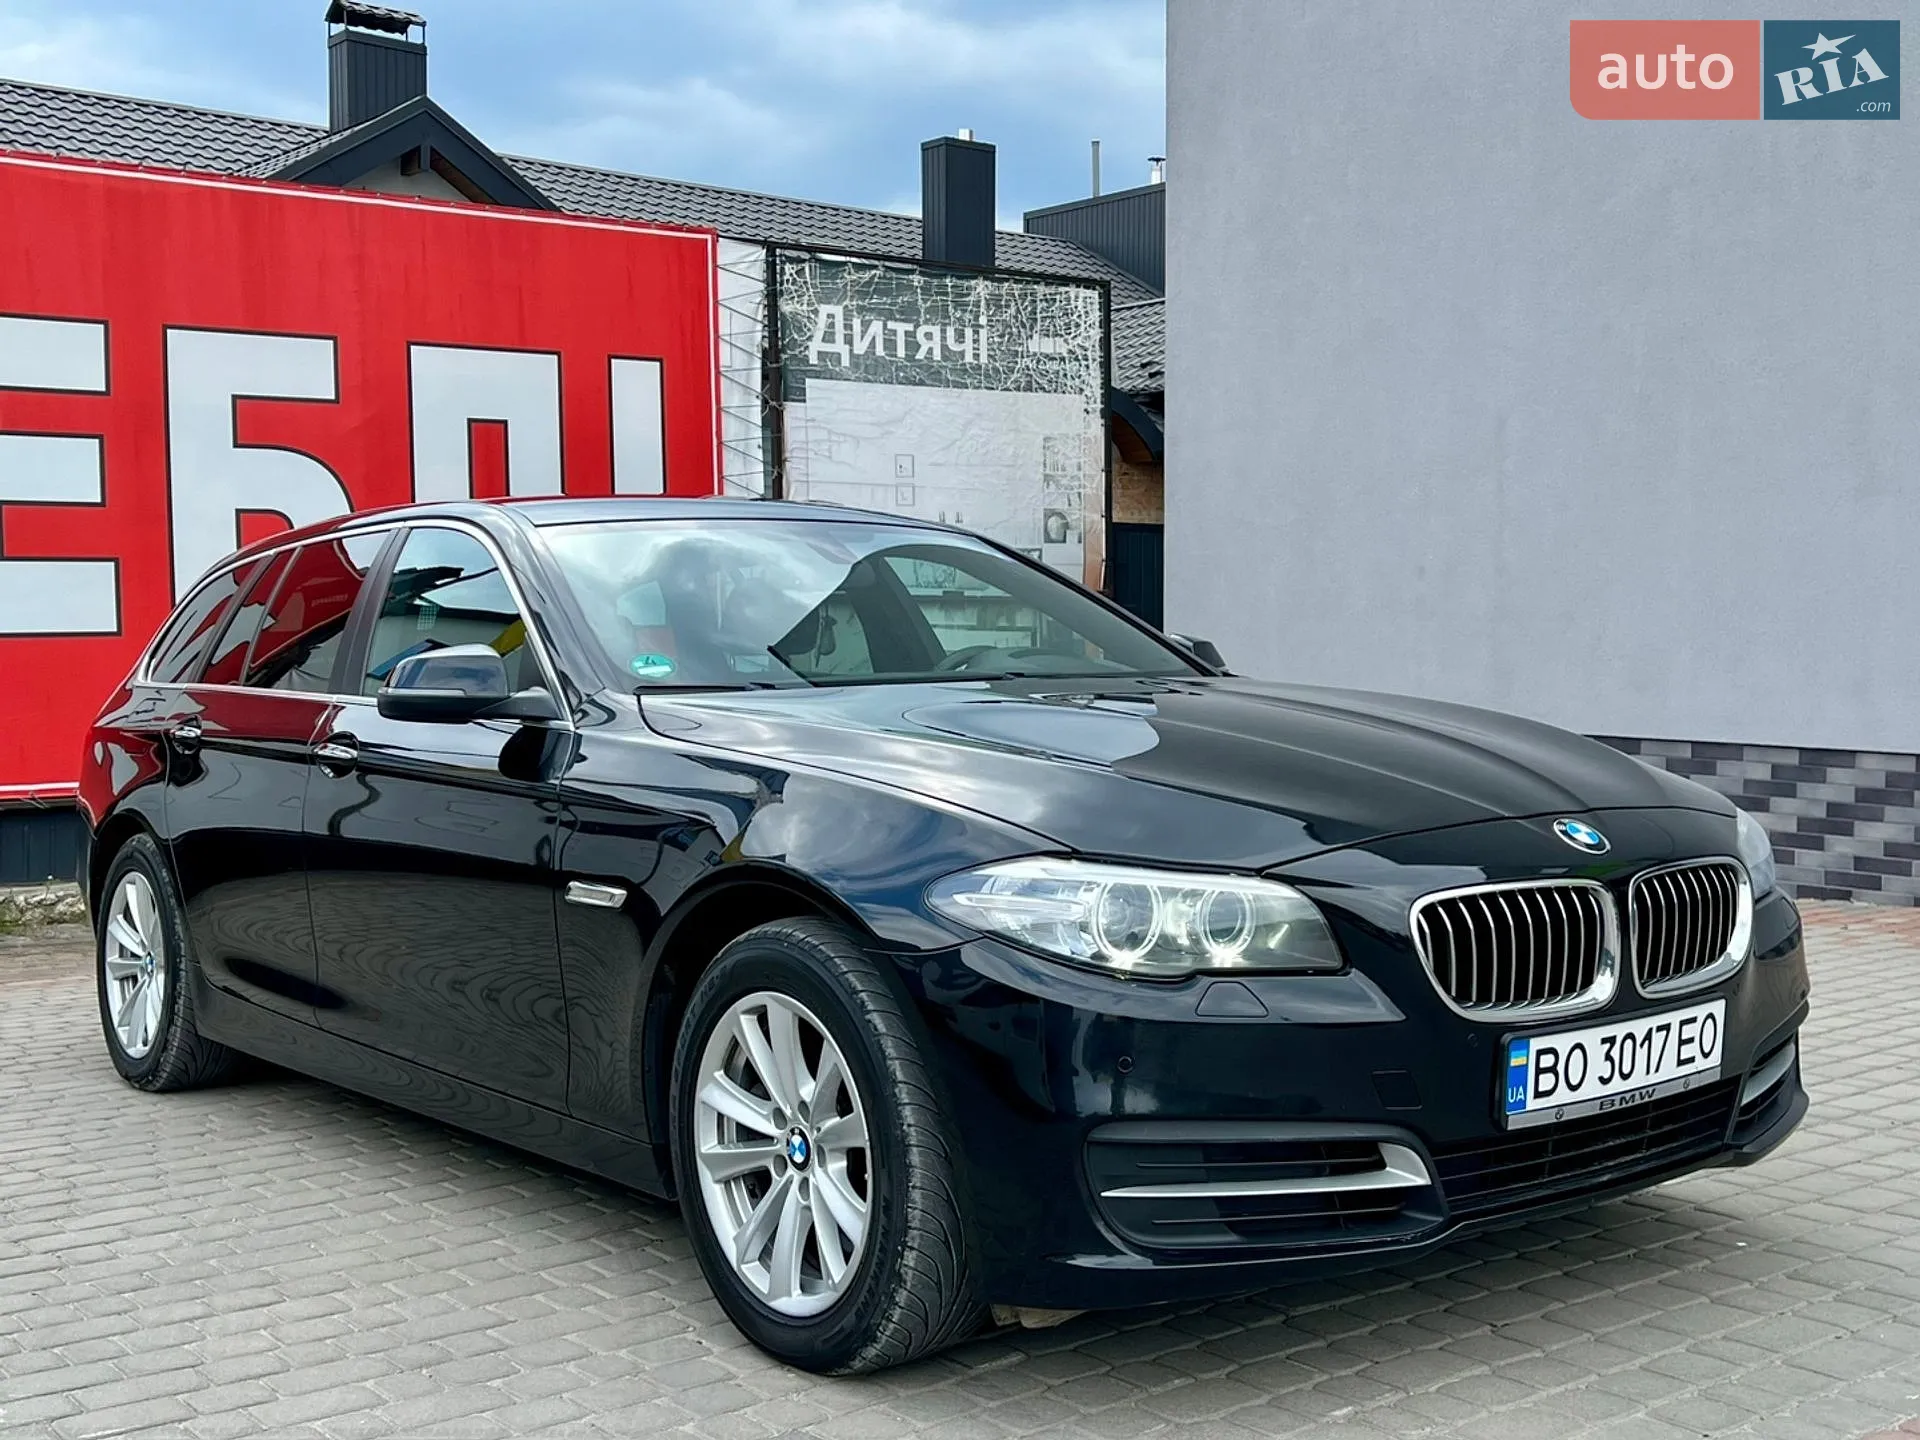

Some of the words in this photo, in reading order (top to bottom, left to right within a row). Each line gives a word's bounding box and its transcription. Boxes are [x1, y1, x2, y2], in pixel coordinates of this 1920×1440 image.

[808, 304, 988, 367] Дитячі
[1533, 1043, 1588, 1100] BO
[1598, 1023, 1672, 1085] 3017
[1677, 1012, 1718, 1067] EO
[1508, 1086, 1526, 1103] UA
[1599, 1088, 1656, 1111] BMW
